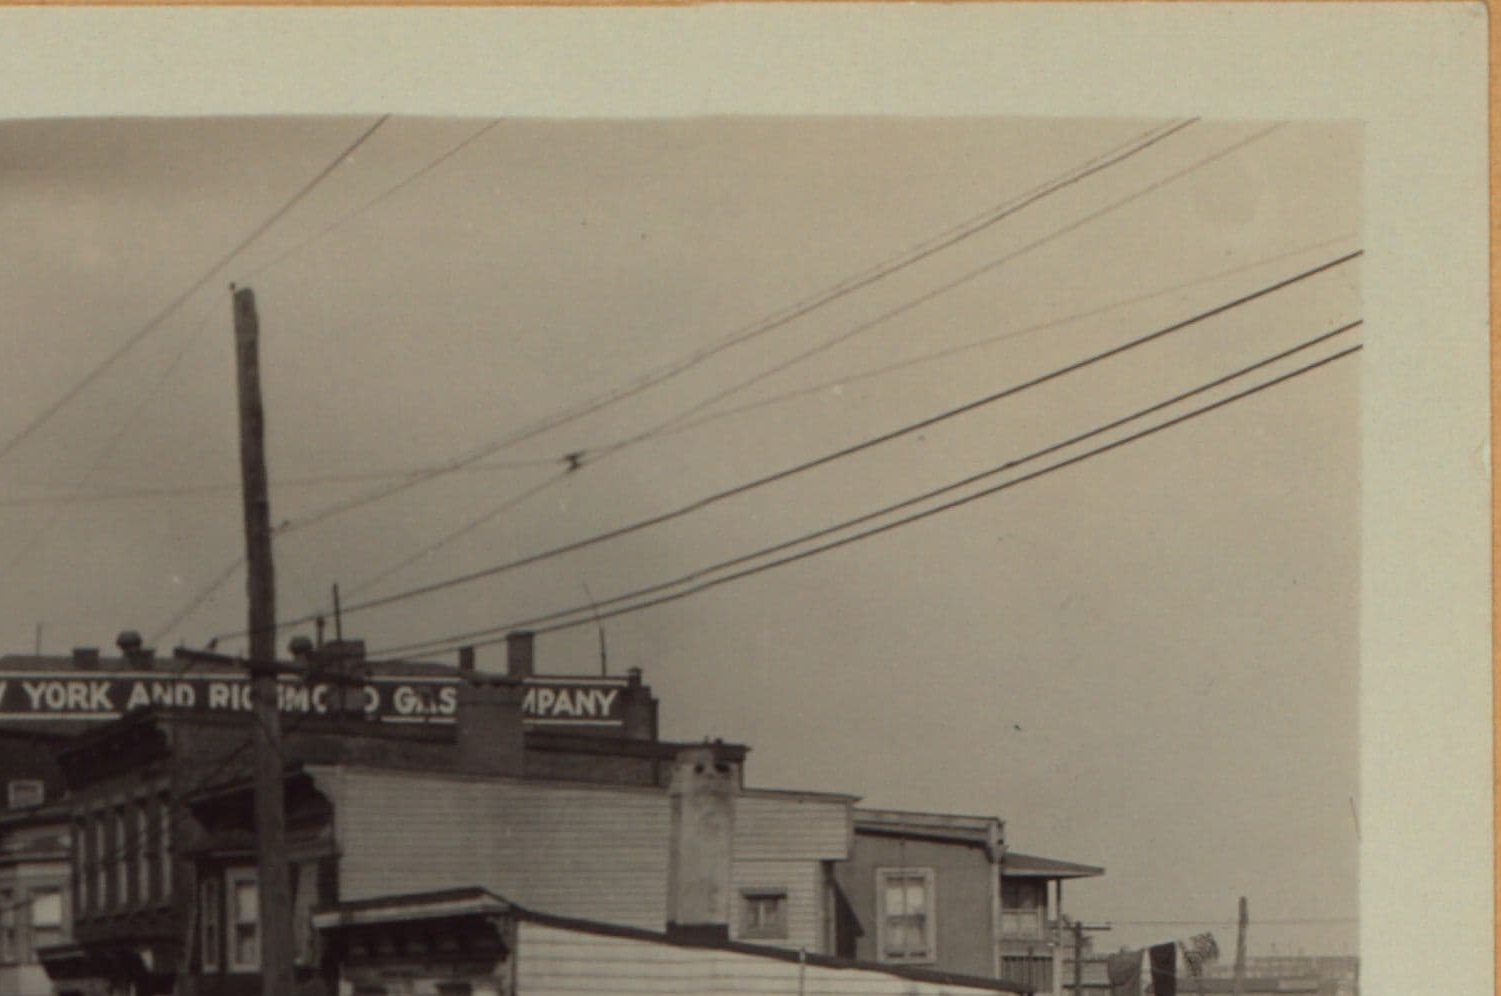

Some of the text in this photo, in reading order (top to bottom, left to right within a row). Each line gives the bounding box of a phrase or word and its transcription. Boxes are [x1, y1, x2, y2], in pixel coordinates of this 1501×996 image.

[22, 679, 114, 711] YORK
[127, 681, 197, 711] AND
[208, 682, 380, 714] RICMOD
